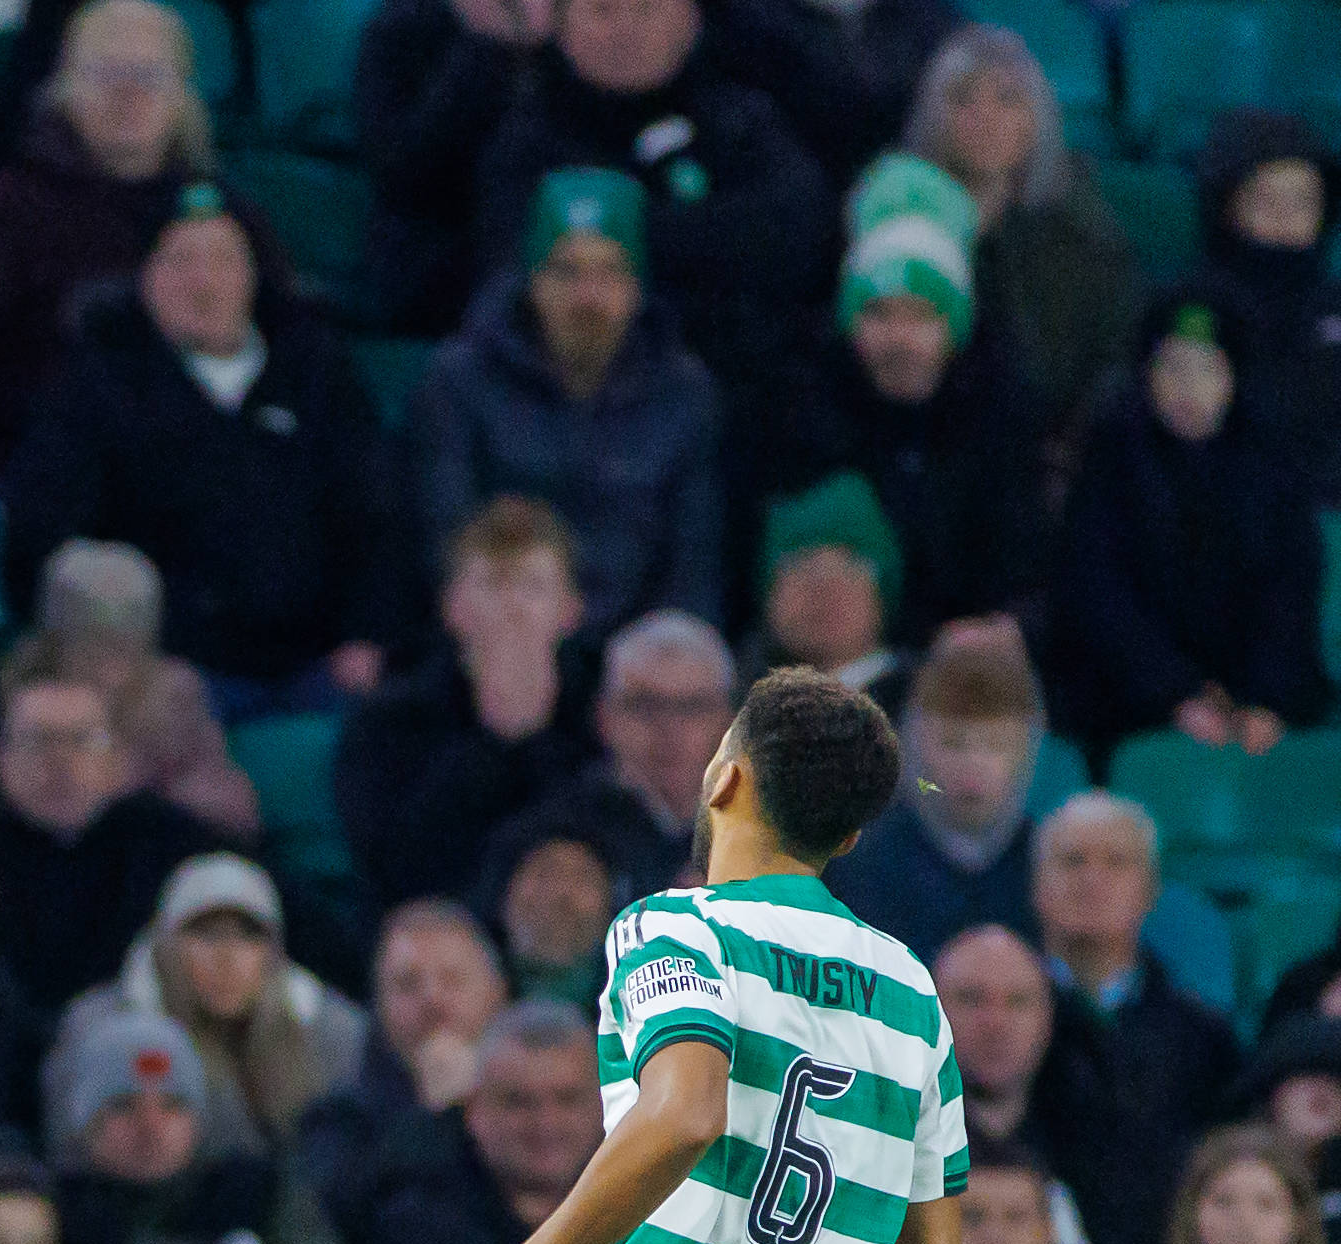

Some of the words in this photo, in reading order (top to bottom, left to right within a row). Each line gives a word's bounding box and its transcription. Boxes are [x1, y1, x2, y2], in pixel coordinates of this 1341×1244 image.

[627, 958, 673, 992] CELTIC
[675, 958, 695, 975] FC
[629, 975, 723, 1010] FOUNDATION
